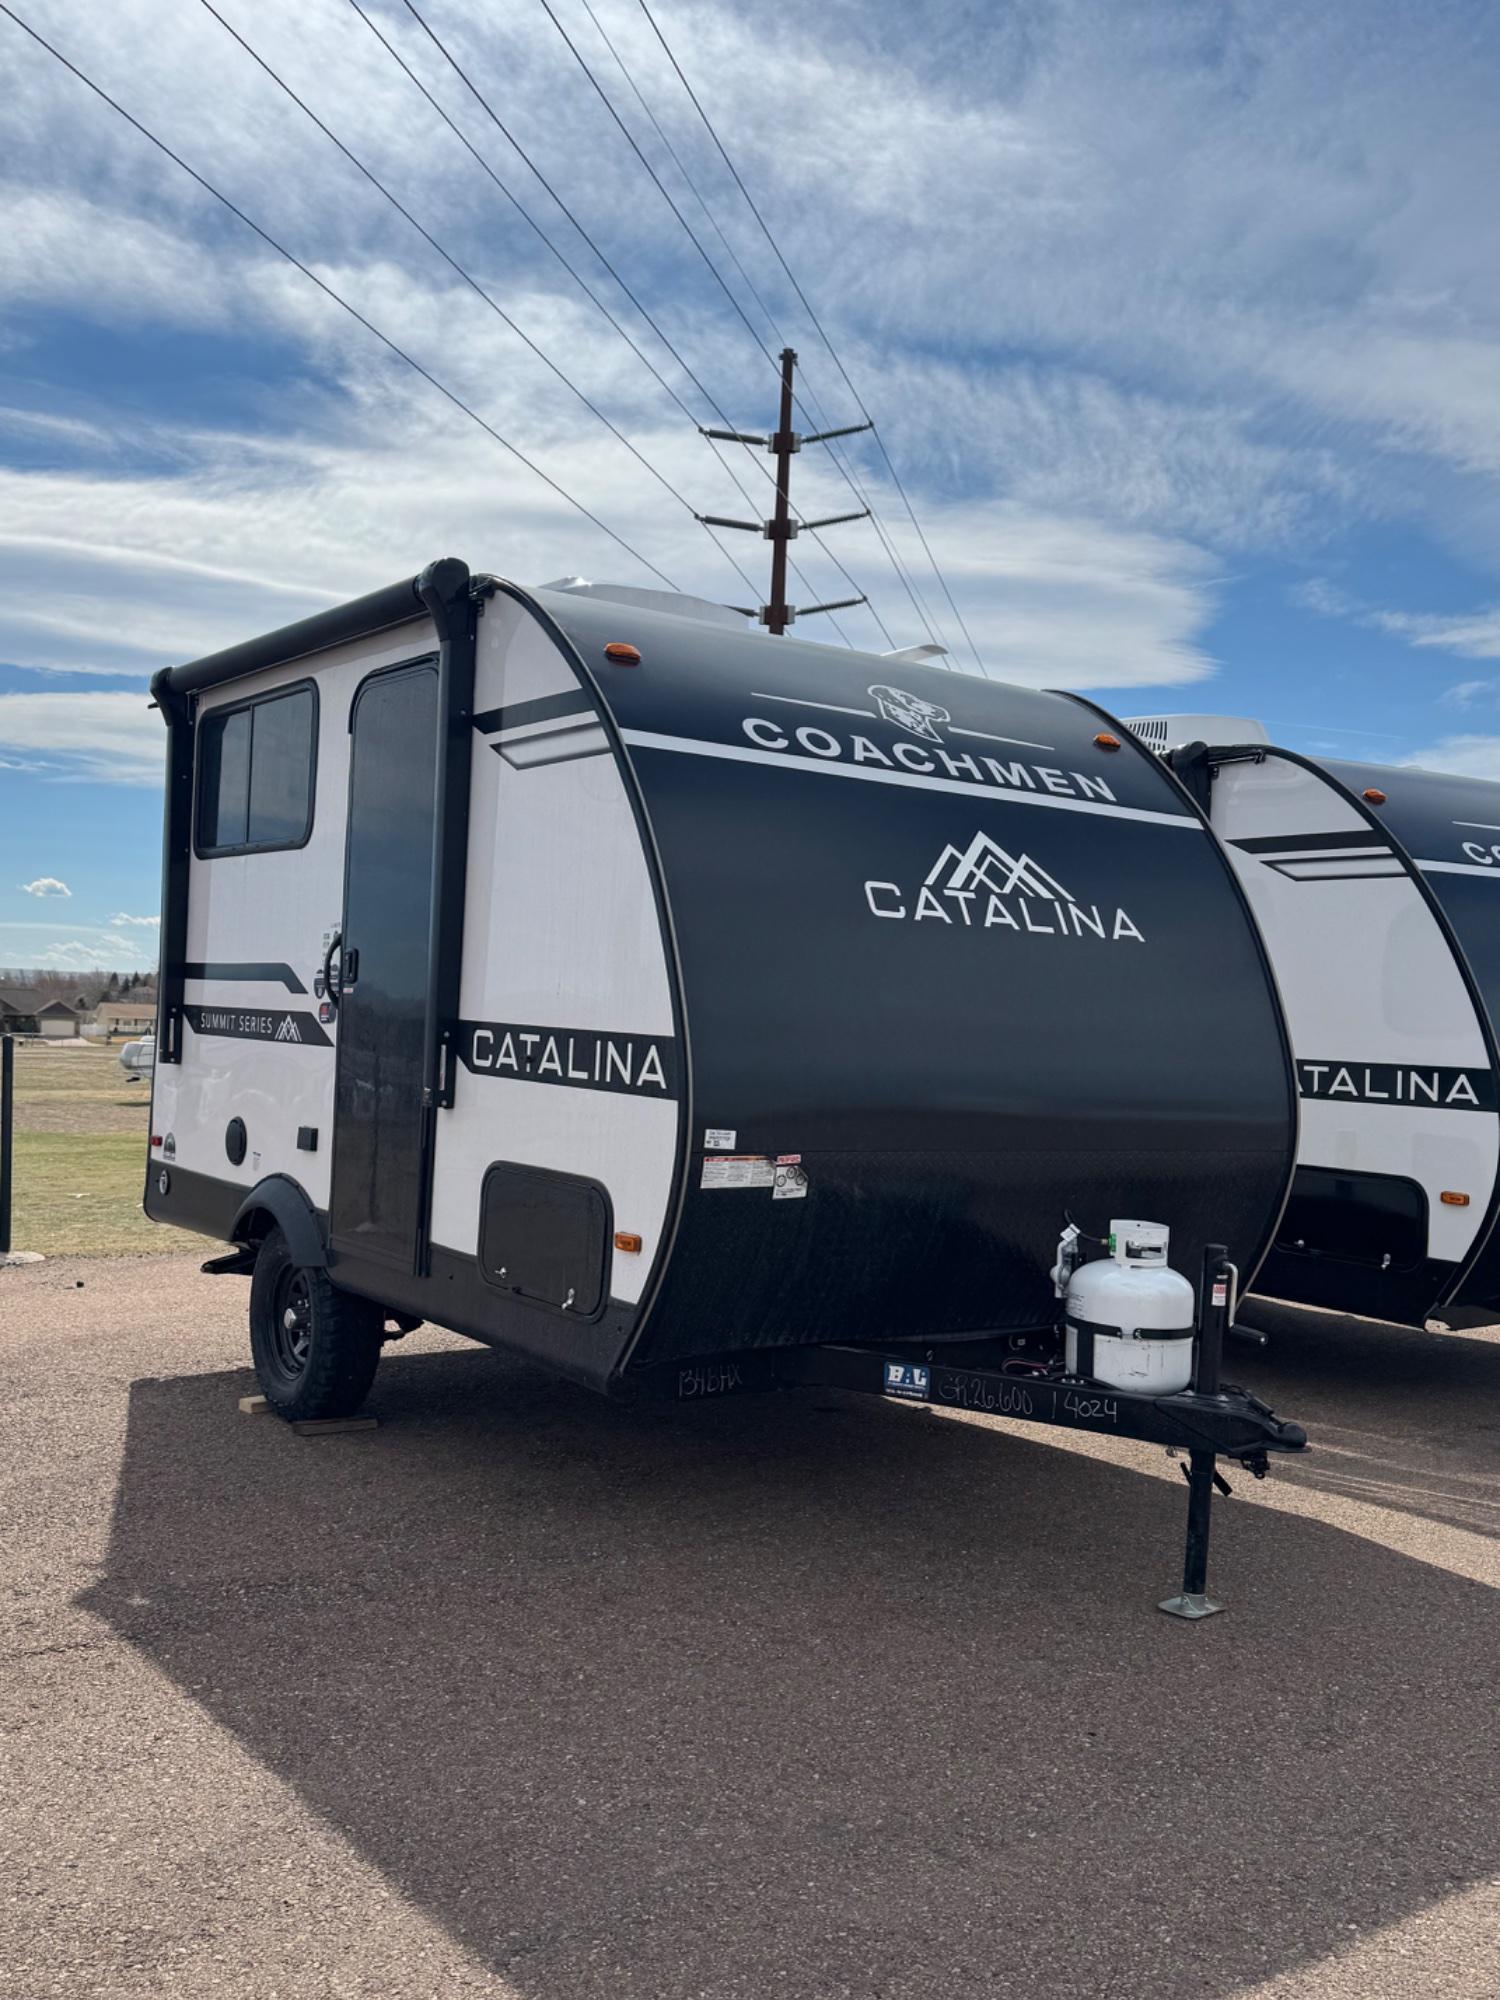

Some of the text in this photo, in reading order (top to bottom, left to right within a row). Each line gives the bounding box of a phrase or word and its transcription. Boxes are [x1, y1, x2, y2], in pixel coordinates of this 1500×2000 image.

[742, 717, 1117, 802] COACHMEN
[864, 879, 1145, 942] CATALINA
[200, 1012, 273, 1034] SUMMIT SERIES
[471, 1029, 668, 1091] CATALINA
[1299, 1065, 1480, 1105] TALINA
